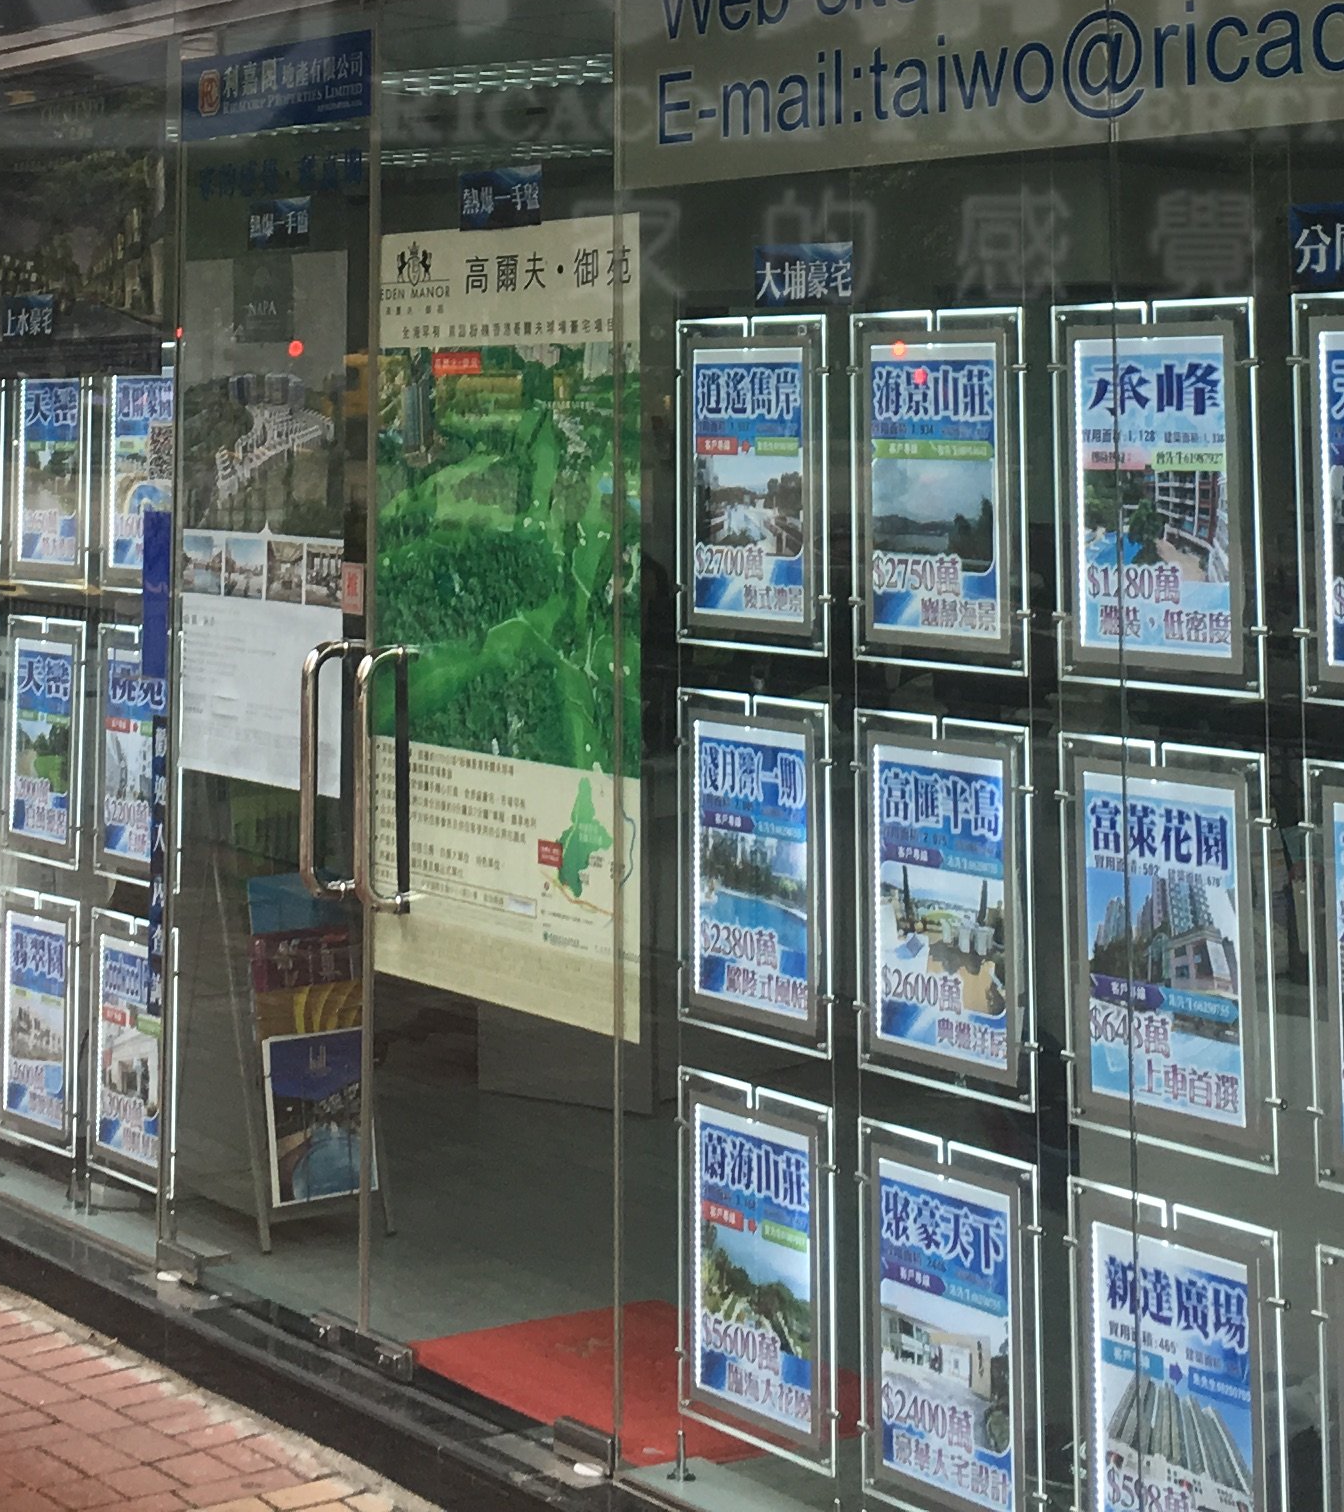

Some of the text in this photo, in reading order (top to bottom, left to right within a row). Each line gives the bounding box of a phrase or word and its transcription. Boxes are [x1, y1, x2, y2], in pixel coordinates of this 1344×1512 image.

[410, 284, 451, 299] MANOR
[756, 260, 852, 300] 大埔豪宅
[3, 307, 53, 338] 上水豪宅
[875, 367, 991, 419] 海景山莊
[695, 544, 764, 583] $2700萬
[873, 554, 961, 597] $2750萬
[882, 770, 999, 839] 富匯半島
[1089, 799, 1229, 871] 富萊花園
[882, 964, 963, 1016] $2600萬
[1138, 1058, 1239, 1114] 上車首選
[702, 1130, 808, 1209] 蔚海山莊
[1105, 1253, 1247, 1350] 新達廣場
[882, 1381, 974, 1456] $2400萬
